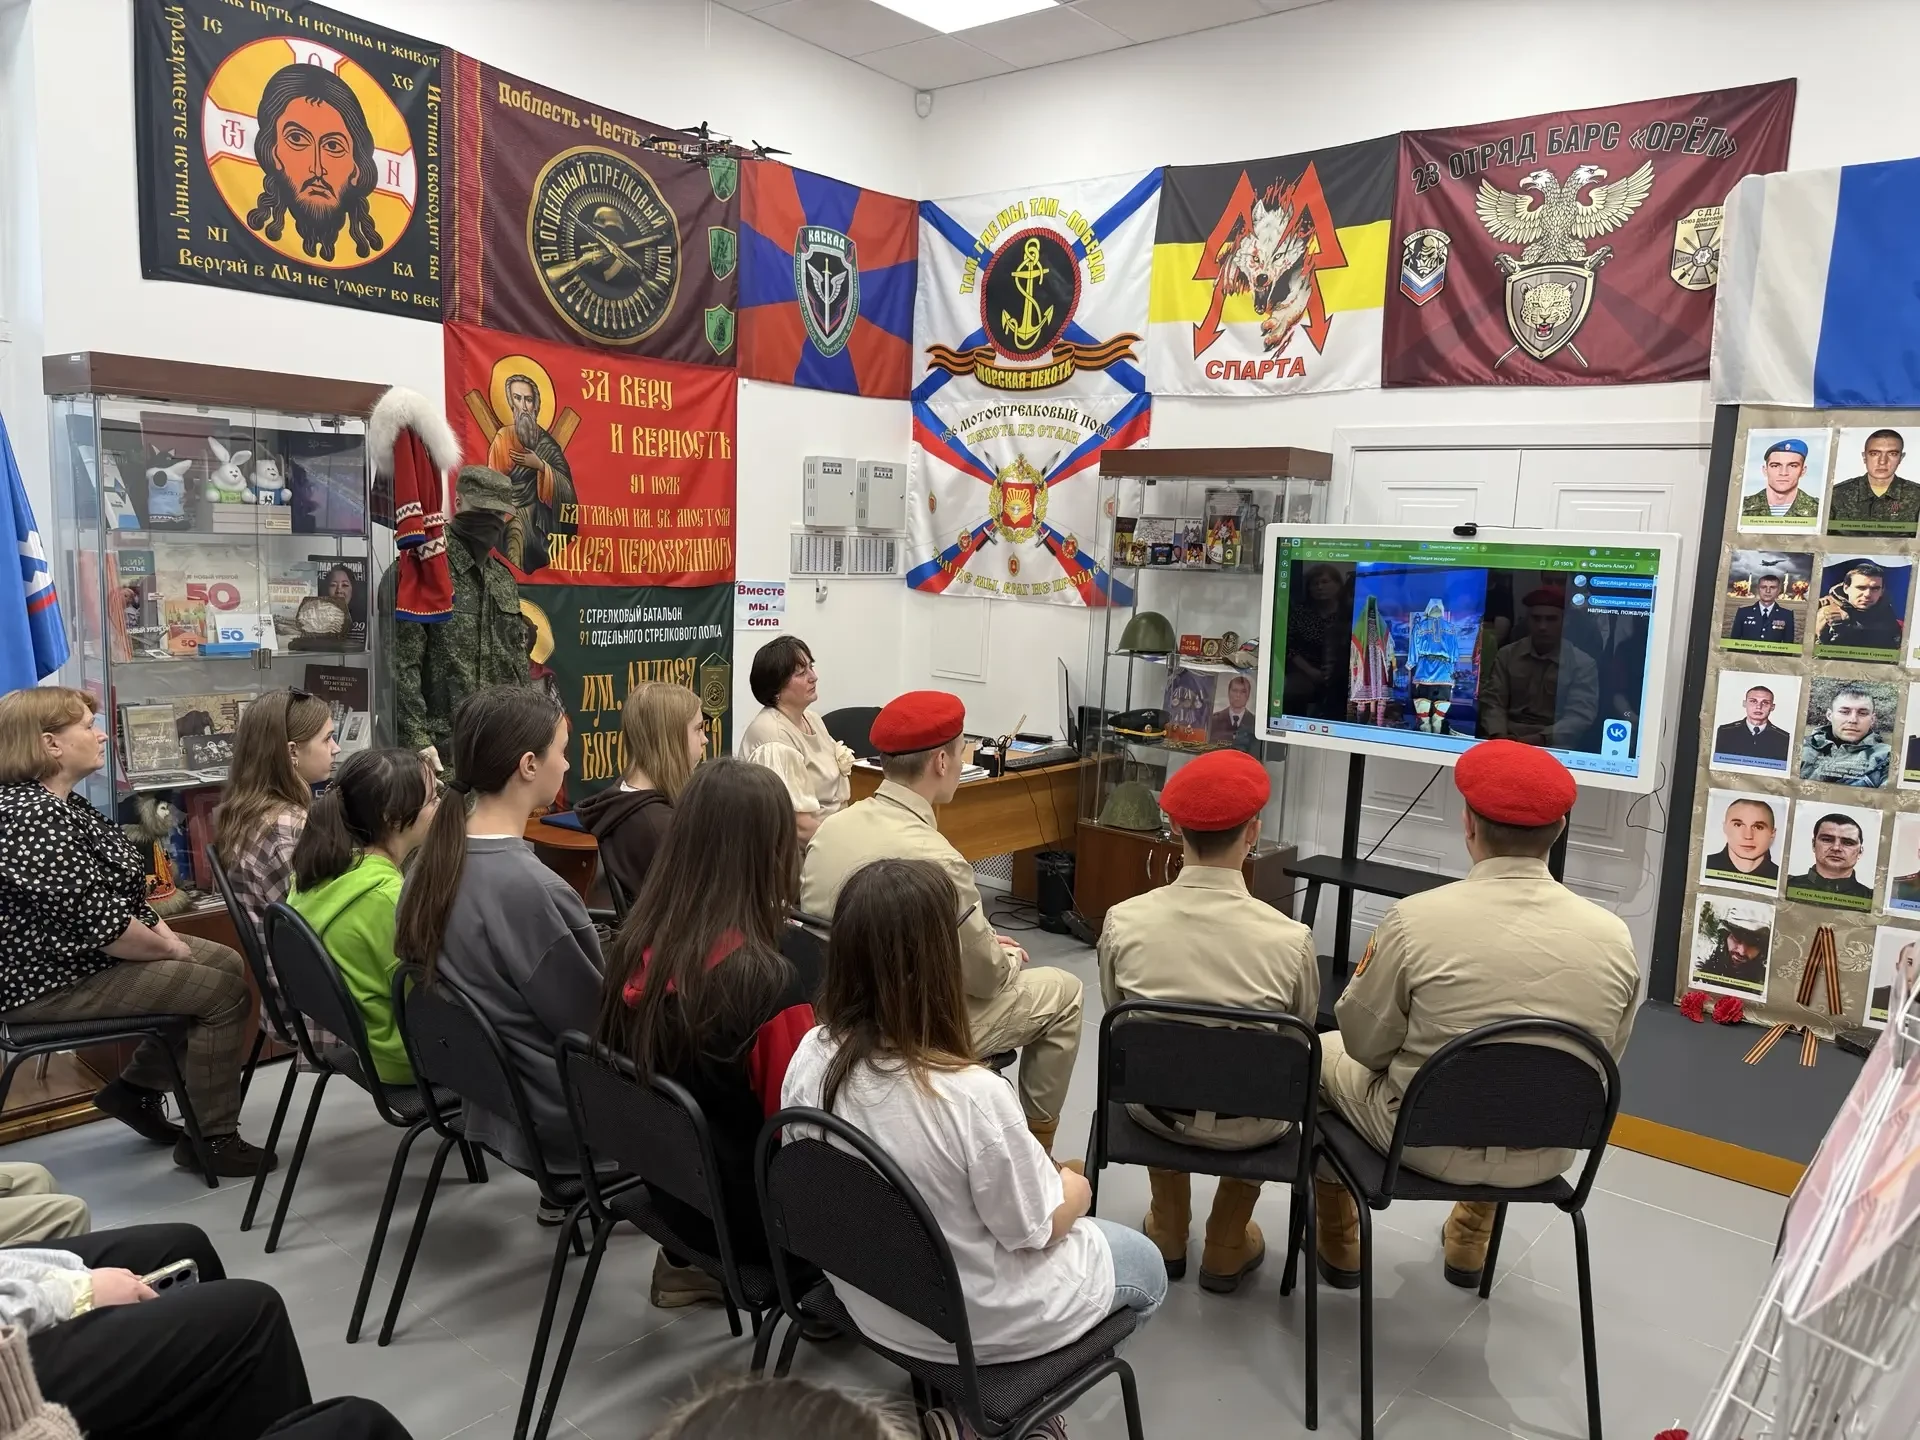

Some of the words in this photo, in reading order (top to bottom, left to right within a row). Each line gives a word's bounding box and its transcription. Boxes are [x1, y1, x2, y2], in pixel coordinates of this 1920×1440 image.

[250, 1, 294, 24] путь
[299, 15, 309, 28] и
[314, 20, 372, 48] истина
[376, 40, 387, 53] и
[391, 44, 440, 68] живот
[1411, 161, 1442, 195] 23
[1448, 131, 1537, 181] ОТРЯД
[1546, 120, 1621, 155] БАРС
[1627, 115, 1738, 159] «ОРЁЛ»
[170, 145, 190, 226] истину
[590, 163, 668, 229] СТРЕЛКОВЫЙ
[540, 161, 588, 241] ОТДЕЛЬНЫЙ
[541, 246, 559, 262] 91
[808, 229, 845, 251] КАСКАД
[960, 256, 980, 295] ТАМ,
[974, 221, 1000, 254] ГДЕ
[997, 201, 1028, 231] МЫ,
[1030, 197, 1060, 218] ТАМ
[1066, 210, 1106, 285] ПОБЕДА!
[178, 248, 248, 277] Веруяй
[254, 263, 265, 277] в
[271, 262, 302, 285] Мя
[307, 275, 328, 289] не
[334, 276, 386, 299] умрет
[391, 289, 409, 302] во
[413, 293, 440, 309] век
[655, 246, 672, 285] ПОЛК
[977, 363, 1026, 389] МОРСКАЯ
[1030, 360, 1072, 388] ПЕХОТА
[1205, 356, 1306, 381] СПАРТА
[580, 368, 610, 403] ЗА
[620, 375, 673, 411] ВЕРУ
[960, 404, 1078, 433] МОТОСТРЕЛКОВЫЙ
[1081, 414, 1116, 440] ПОЛК
[966, 423, 1016, 446] ПЕХОТА
[1017, 424, 1035, 440] ИЗ
[1038, 424, 1081, 446] СТАЛИ
[610, 423, 624, 454] И
[632, 426, 732, 460] ВЕРНОСТЬ
[630, 474, 645, 495] 91
[651, 475, 680, 495] ПОЛК
[559, 503, 629, 528] БАТАЛЬОН
[633, 508, 654, 528] ИМ.
[657, 508, 673, 529] СВ.
[677, 508, 731, 528] АПОСТОЛА
[547, 532, 614, 578] АНДРЕЯ
[618, 537, 732, 574] ПЕРВОЗВАННОГО
[187, 582, 241, 611] 50
[738, 584, 785, 597] Вместе
[1003, 582, 1029, 596] ВРАГ
[1032, 583, 1051, 595] НЕ
[579, 608, 584, 623] 2
[586, 605, 641, 624] СТРЕЛКОВЫЙ
[643, 606, 683, 622] БАТАЛЬОН
[749, 602, 768, 611] мы
[221, 630, 244, 641] 50
[352, 622, 365, 631] 29
[579, 633, 589, 646] 91
[591, 629, 643, 648] ОТДЕЛЬНОГО
[644, 626, 698, 643] СТРЕЛКОВОГО
[698, 624, 722, 640] ПОЛКА
[748, 616, 779, 627] сила
[580, 674, 624, 728] ИМ.
